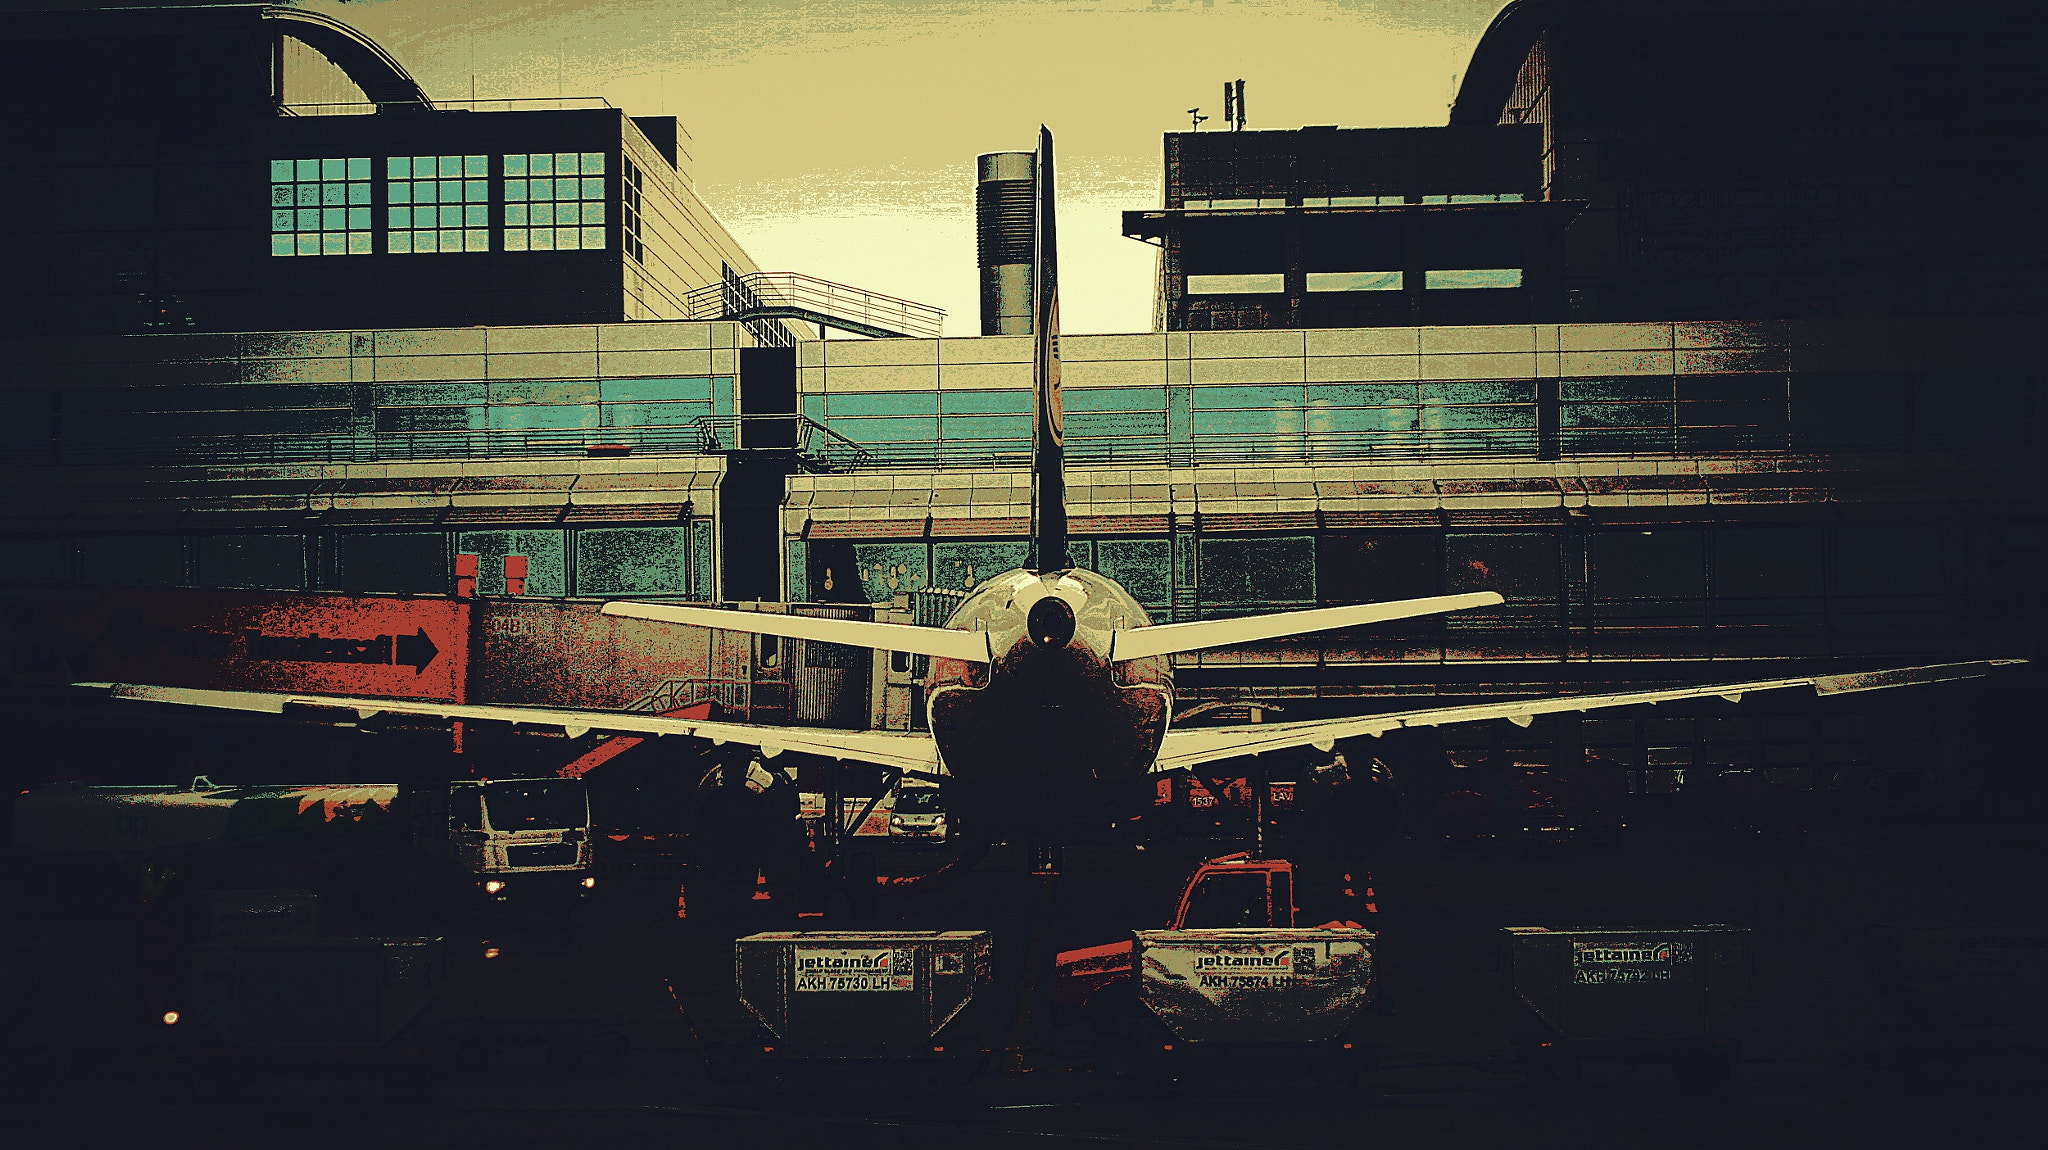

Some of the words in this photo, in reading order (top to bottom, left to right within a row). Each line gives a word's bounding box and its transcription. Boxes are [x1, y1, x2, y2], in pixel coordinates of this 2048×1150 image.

[1192, 796, 1215, 806] 1537
[1196, 951, 1290, 969] jettainer
[1574, 943, 1668, 965] jettainer
[797, 952, 889, 971] jettainer
[1199, 975, 1228, 987] AKH
[1272, 975, 1291, 987] LH
[1575, 970, 1606, 983] AKH
[797, 977, 827, 990] AKH
[830, 977, 869, 990] 75730
[873, 977, 890, 990] LH
